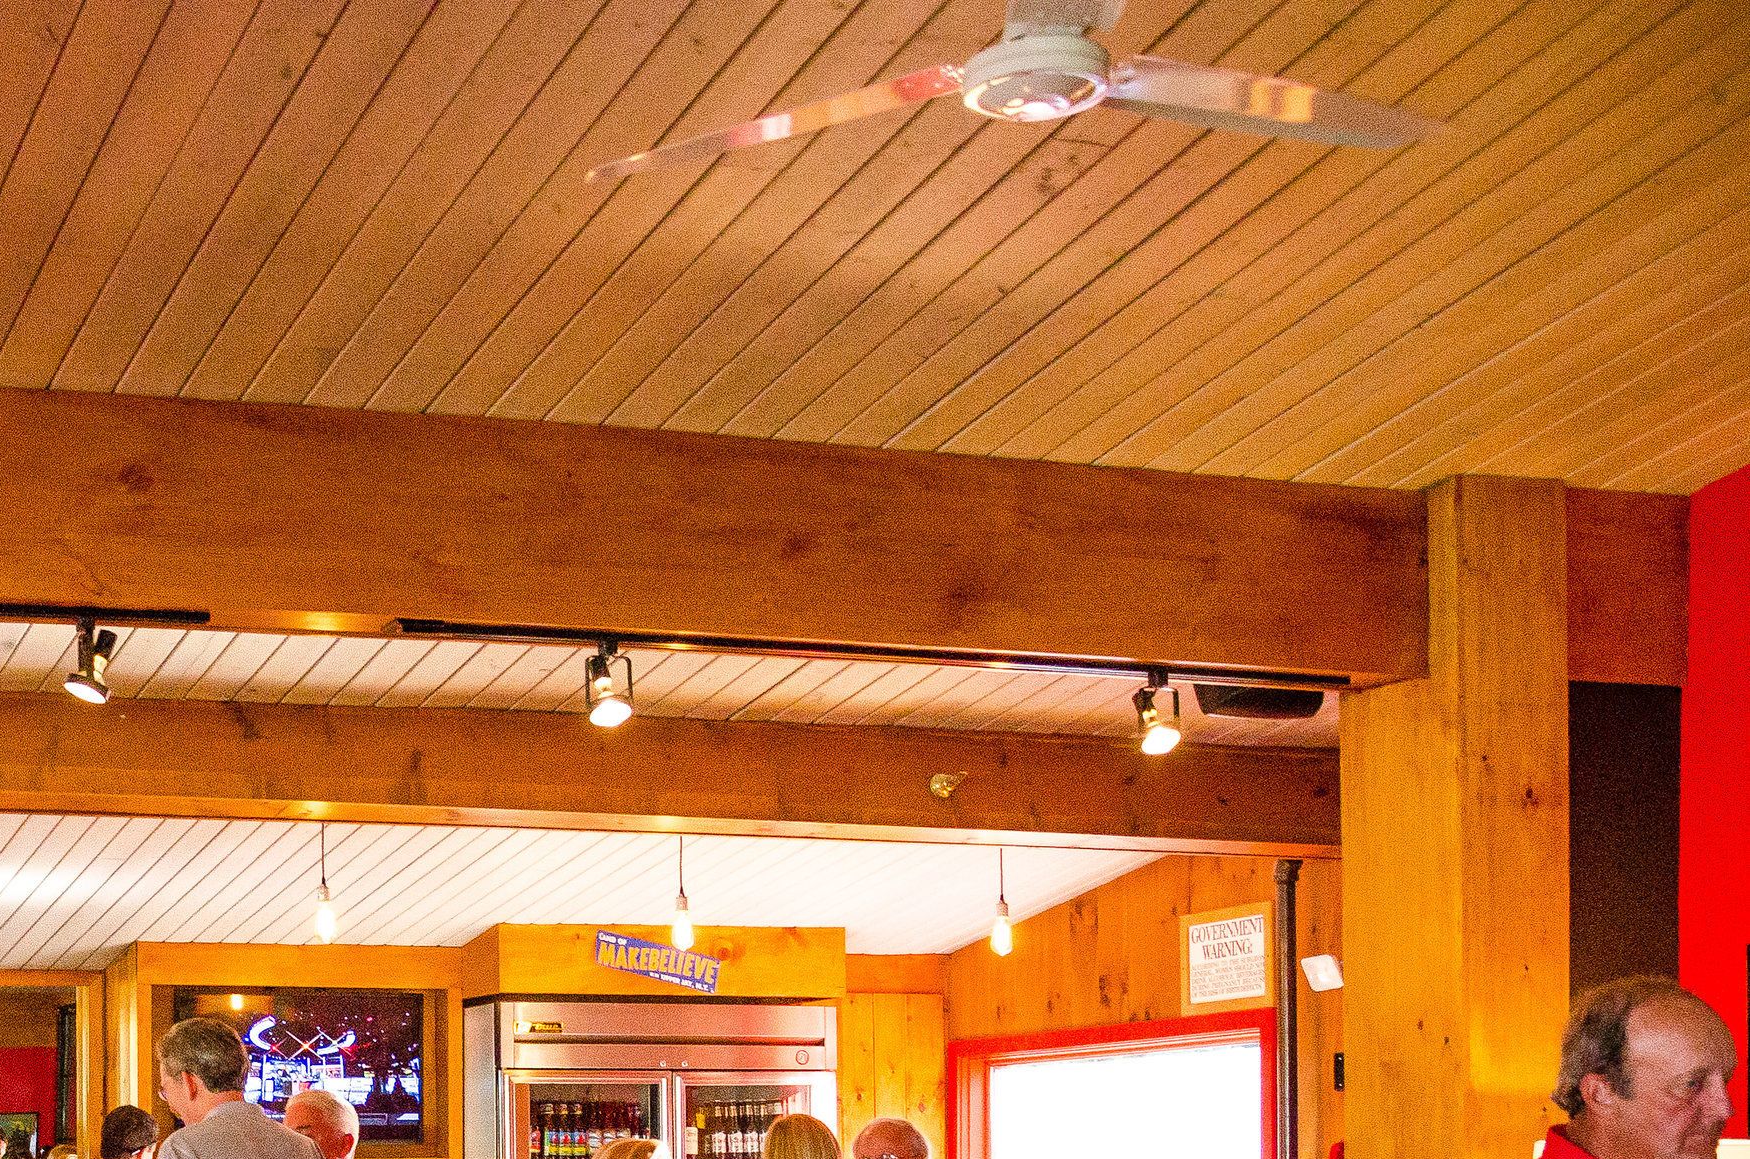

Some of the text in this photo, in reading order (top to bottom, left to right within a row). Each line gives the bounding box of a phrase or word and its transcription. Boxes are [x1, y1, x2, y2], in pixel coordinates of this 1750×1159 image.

[1191, 917, 1263, 944] GOVERNMENT
[598, 941, 717, 984] MAKEBELIEVE
[1202, 938, 1253, 961] WARNING:
